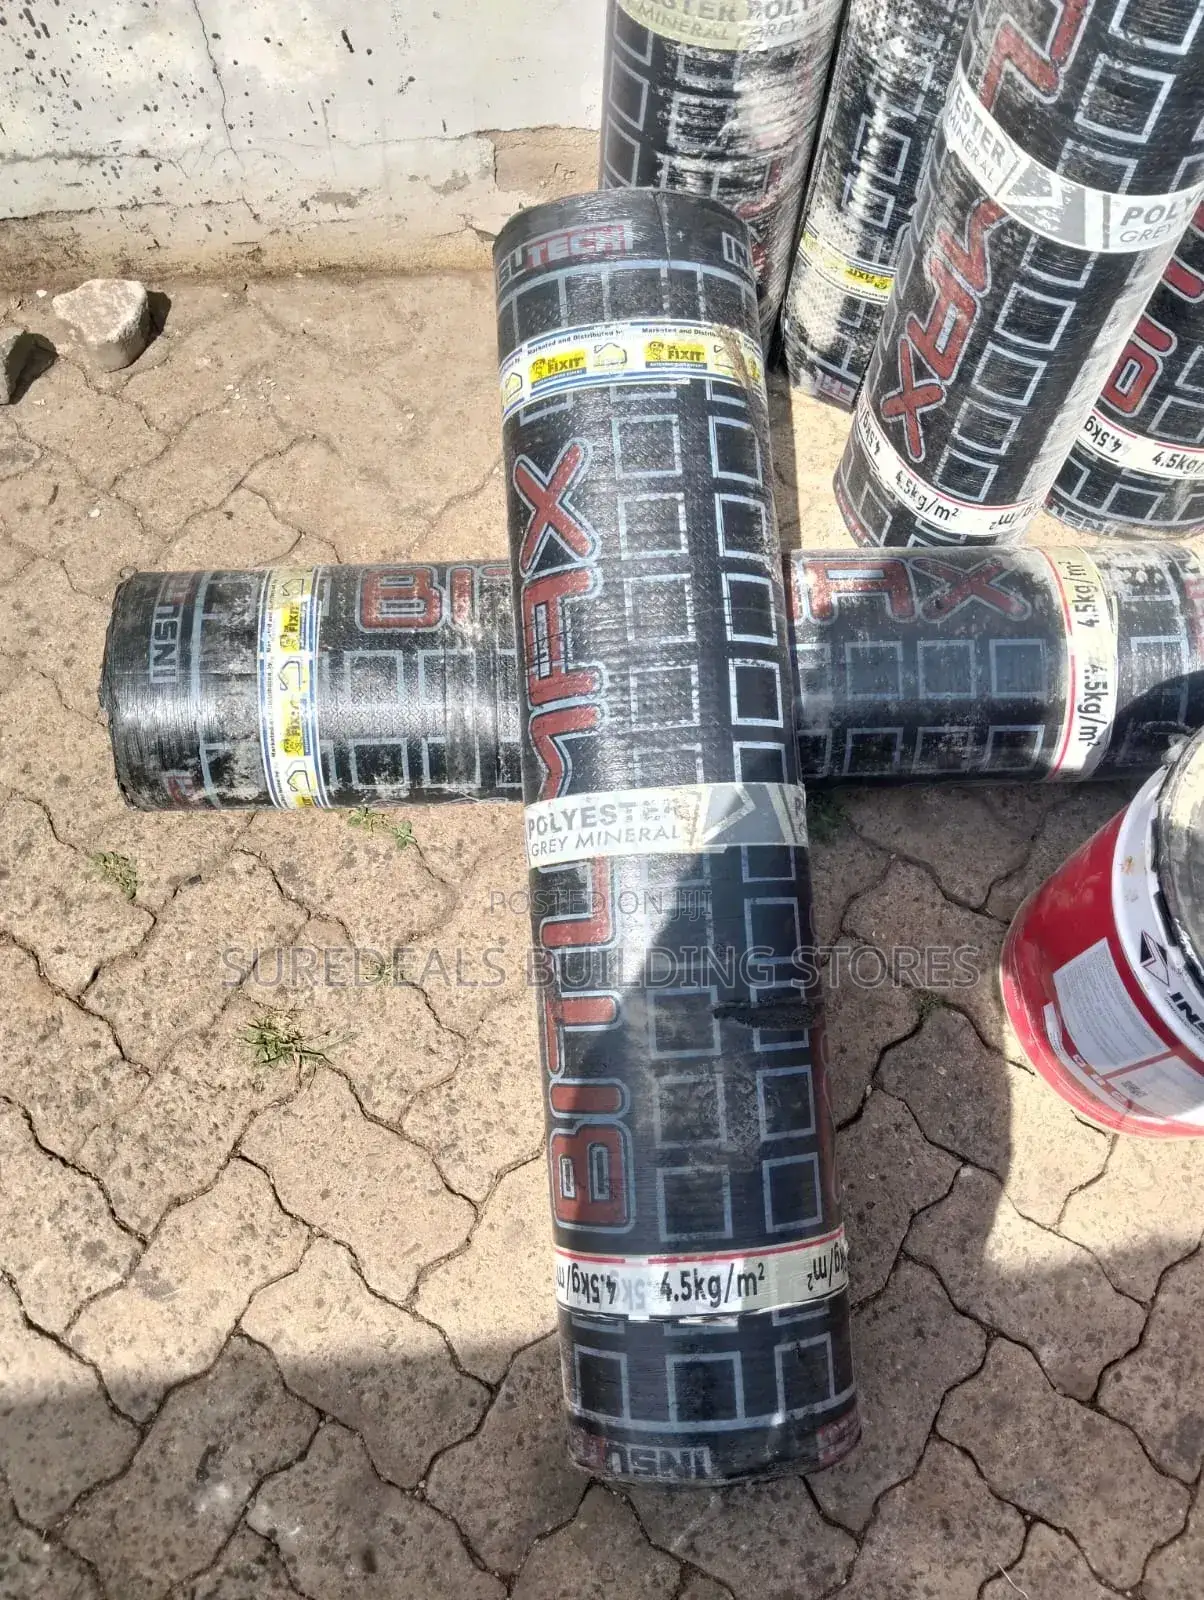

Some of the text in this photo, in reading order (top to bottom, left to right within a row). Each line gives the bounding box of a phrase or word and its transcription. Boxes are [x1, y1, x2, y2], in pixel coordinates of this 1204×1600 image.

[639, 3, 728, 40] MINERAL
[1119, 224, 1171, 244] GREY
[527, 340, 556, 355] Marketed
[558, 336, 571, 344] and
[573, 330, 614, 341] Distributed
[528, 797, 685, 841] POLYESTER
[531, 825, 681, 857] GREY MINERAL
[659, 1262, 765, 1307] 4.5kg/m²
